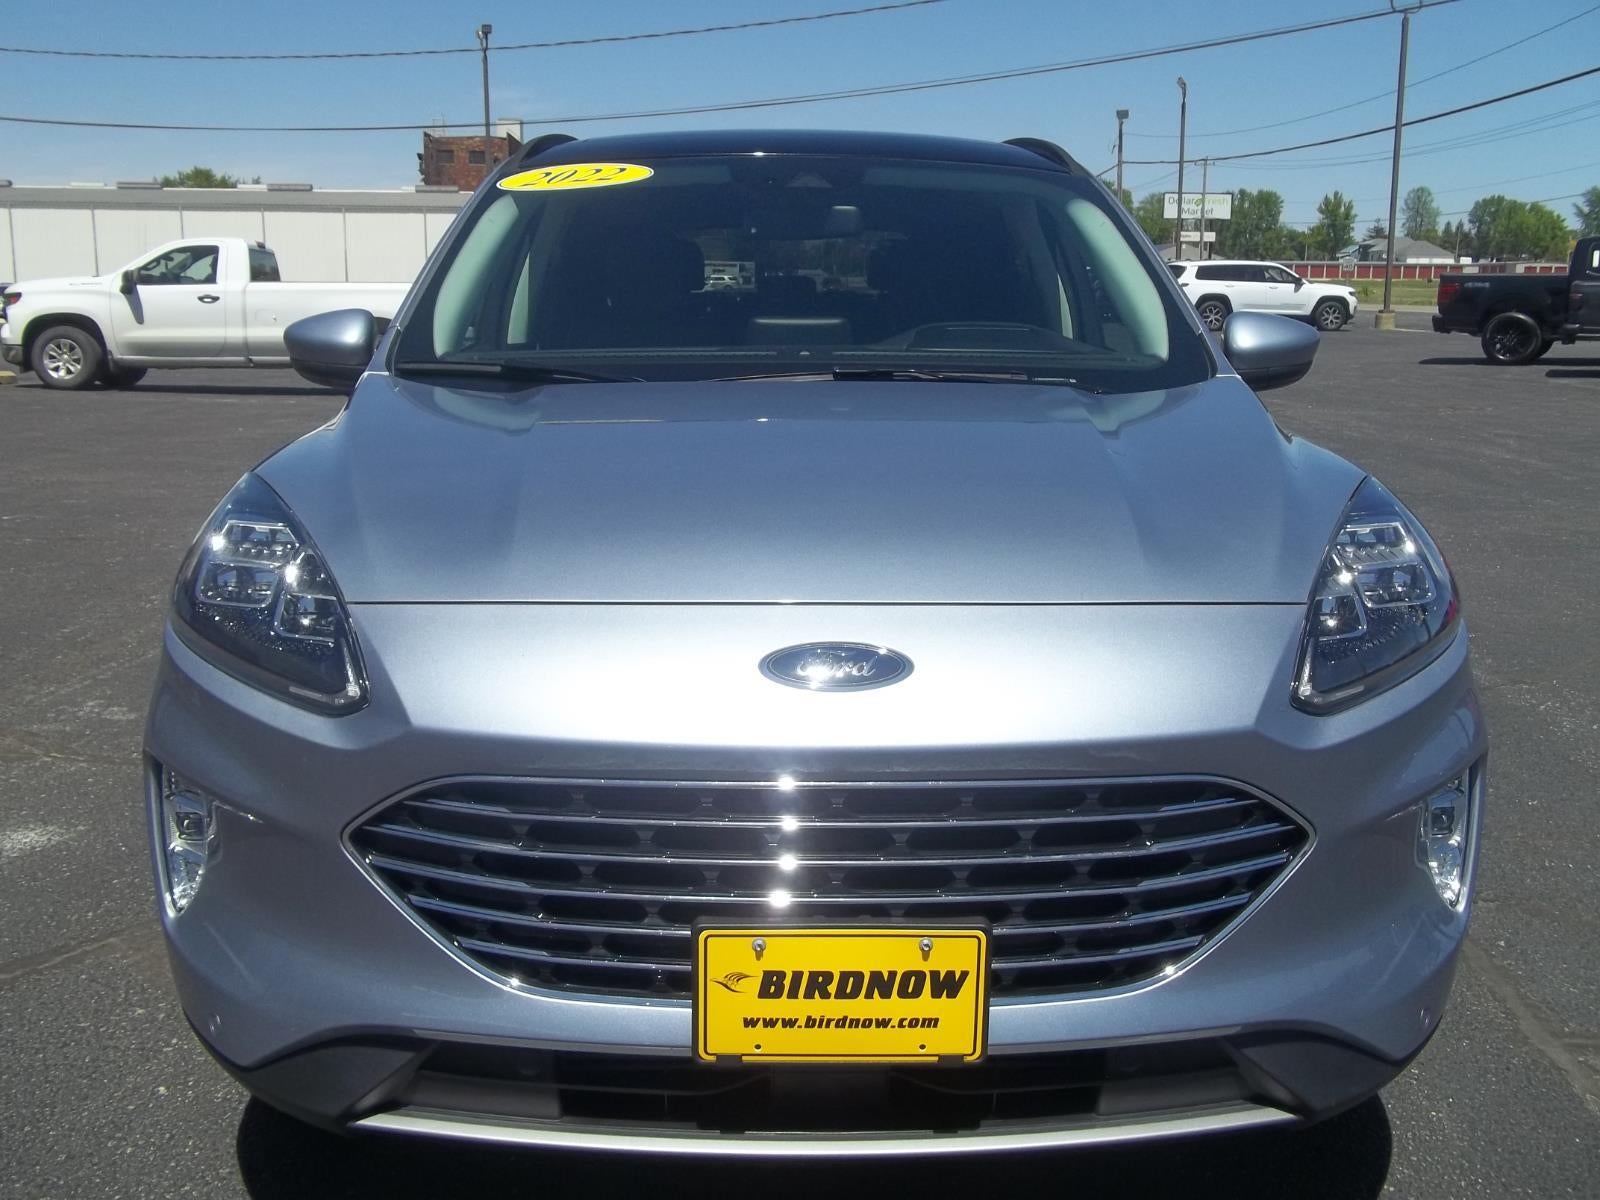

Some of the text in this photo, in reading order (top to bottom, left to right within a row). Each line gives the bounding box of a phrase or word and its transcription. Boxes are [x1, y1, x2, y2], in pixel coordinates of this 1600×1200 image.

[519, 167, 627, 187] 2022
[1168, 196, 1194, 205] Dolar
[1181, 207, 1214, 216] Maret
[757, 969, 970, 1000] BIRDNOW
[742, 1015, 940, 1029] www.birdnow.com
